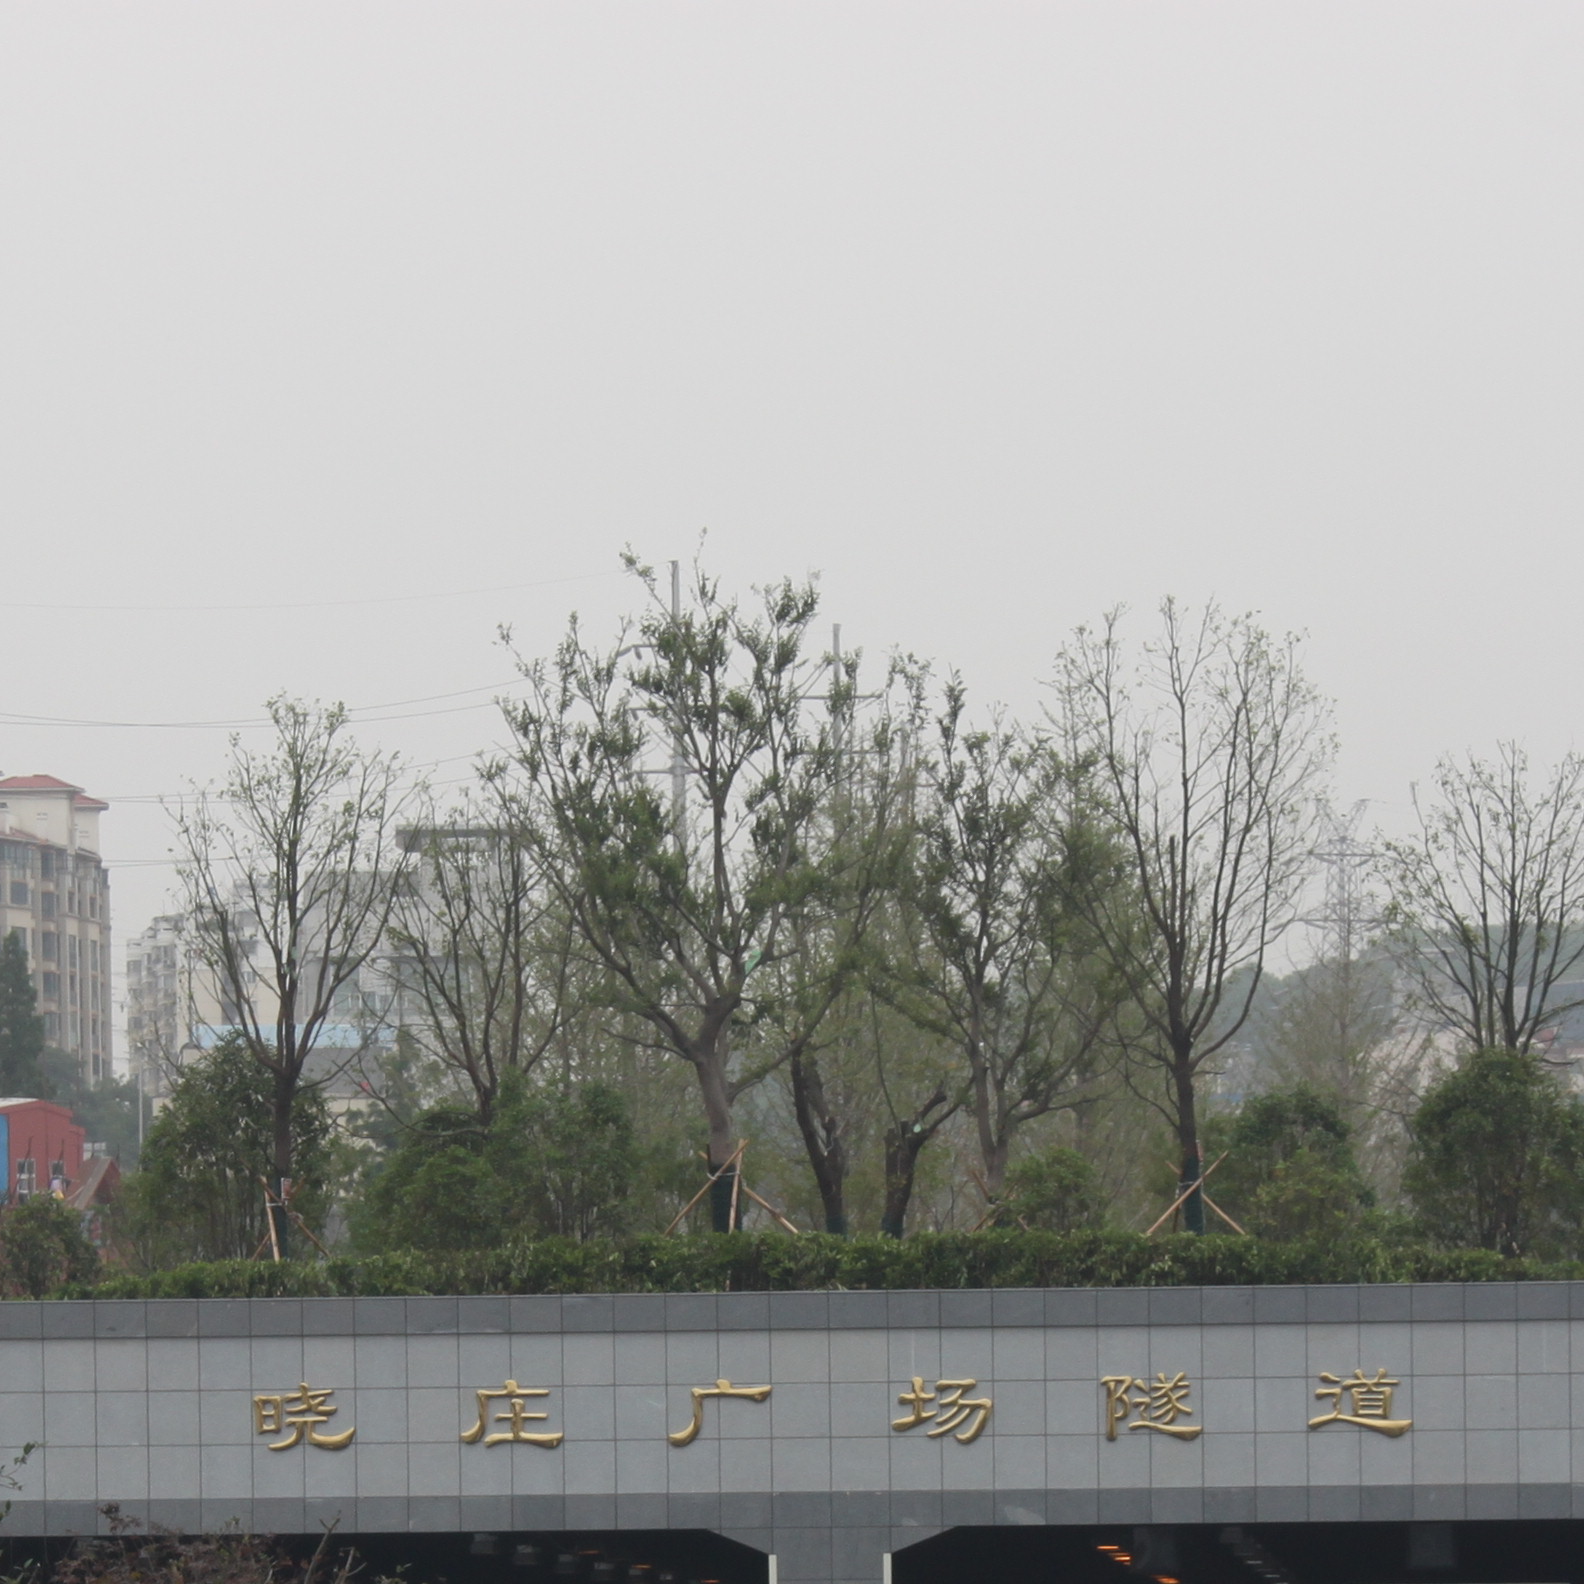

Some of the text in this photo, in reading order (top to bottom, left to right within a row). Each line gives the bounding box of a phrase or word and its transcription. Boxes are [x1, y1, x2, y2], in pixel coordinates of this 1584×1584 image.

[253, 1368, 1413, 1451] 晓庄广场隧道
